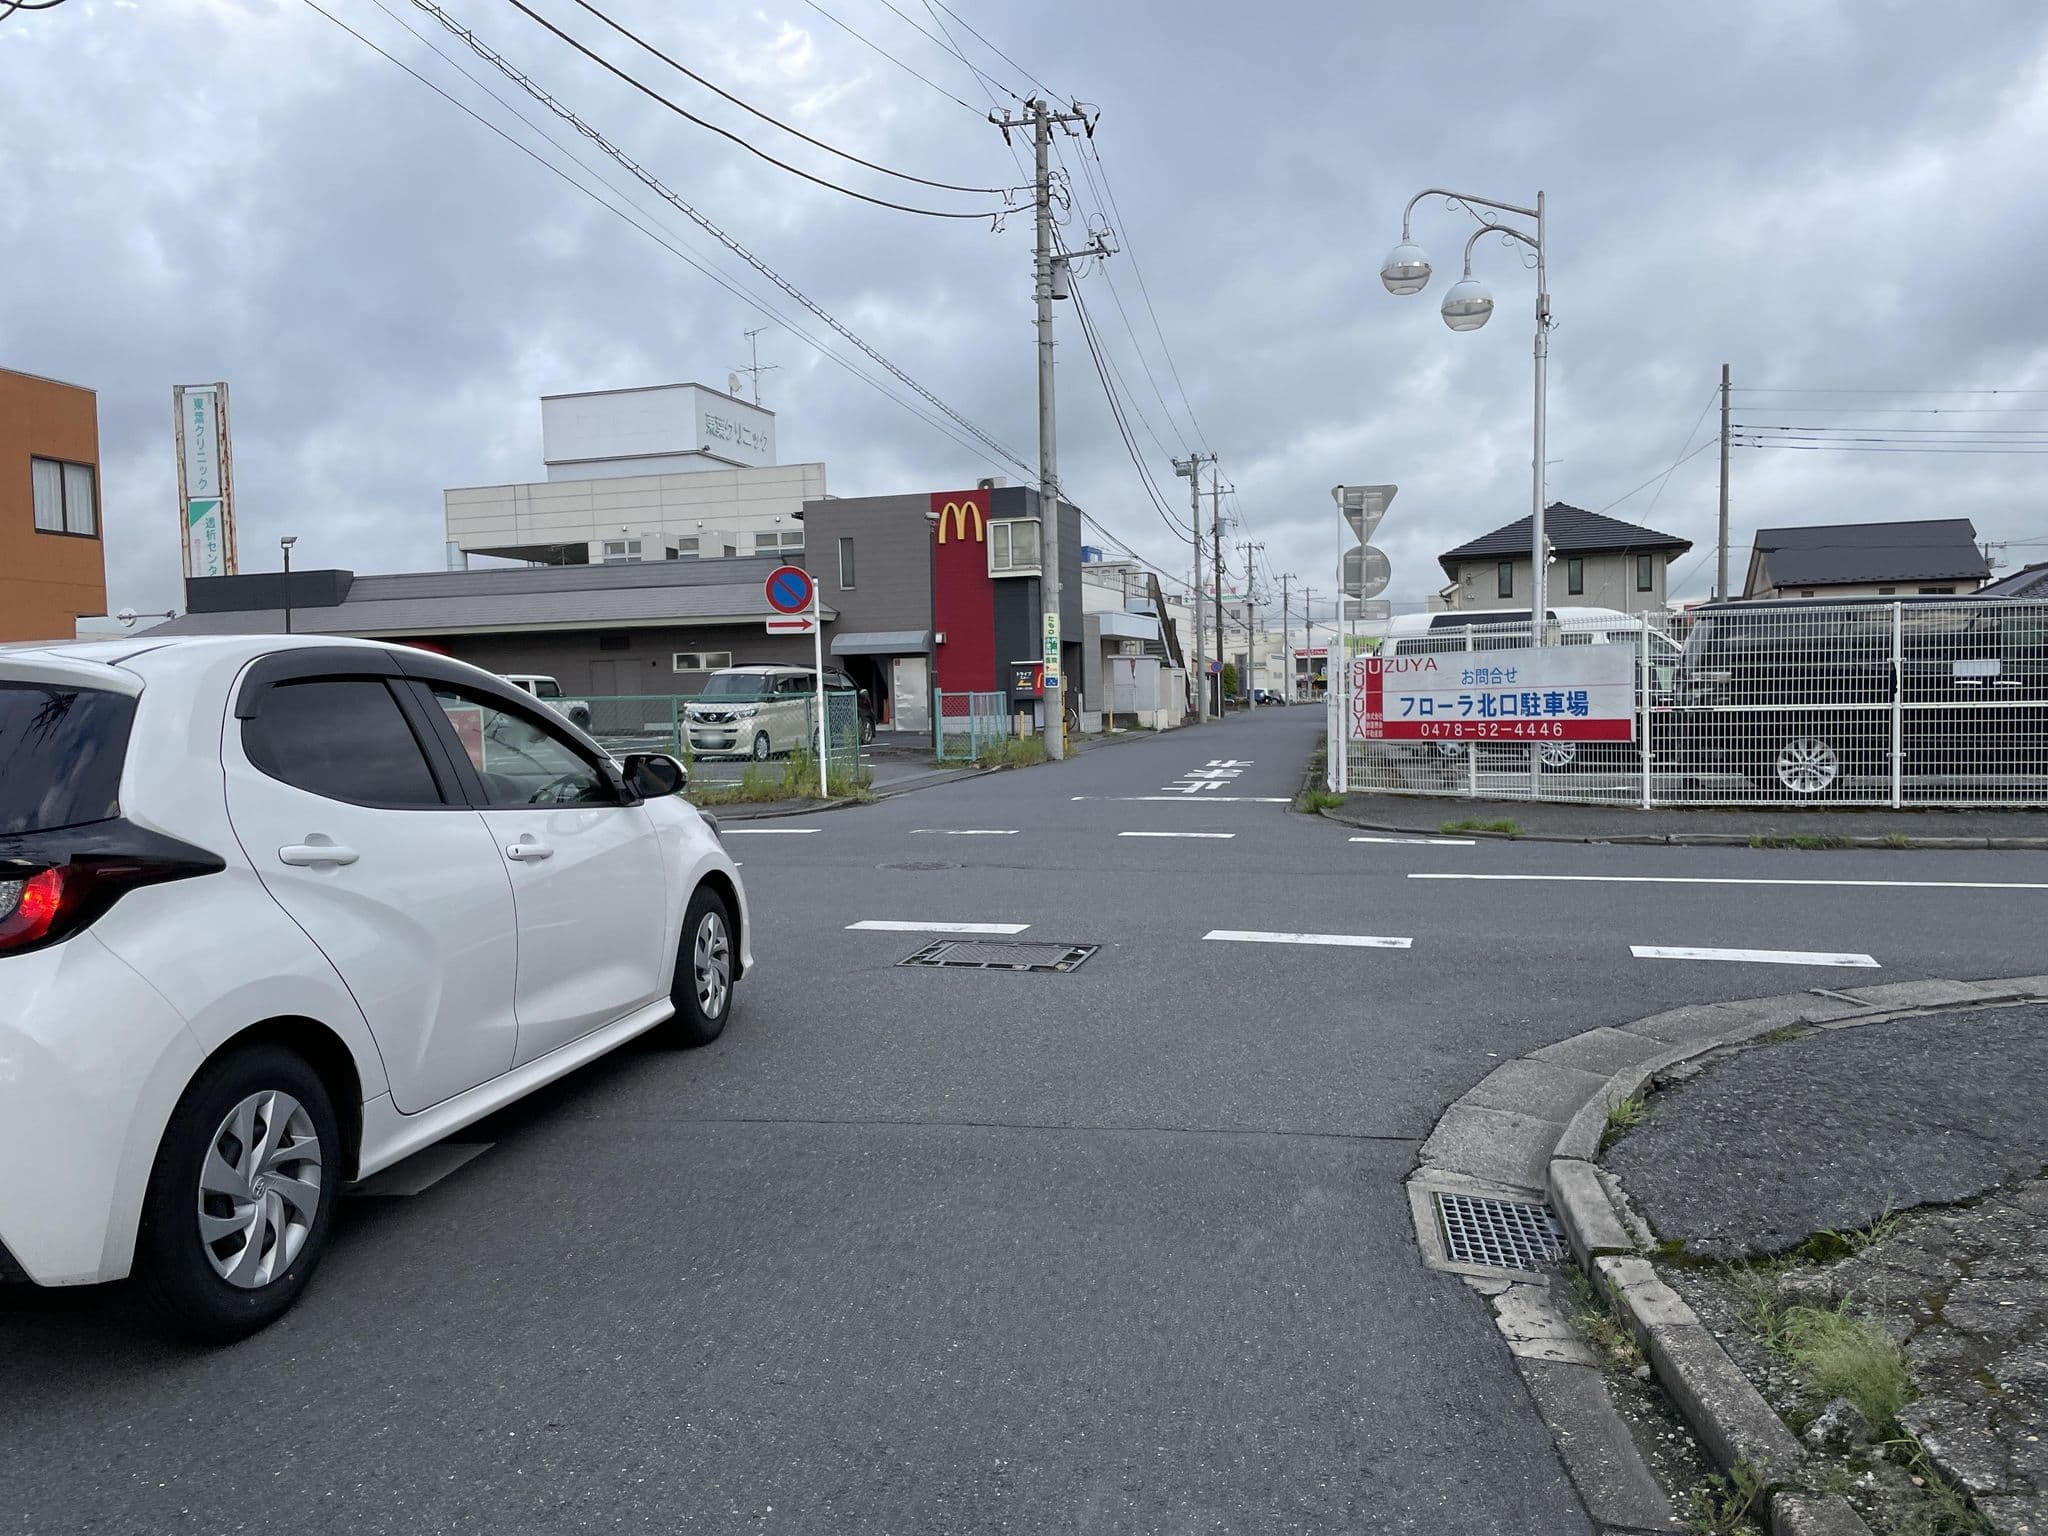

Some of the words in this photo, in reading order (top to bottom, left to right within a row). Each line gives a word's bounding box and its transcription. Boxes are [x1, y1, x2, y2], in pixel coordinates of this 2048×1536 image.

[1461, 667, 1518, 685] お問合せ
[1400, 690, 1590, 717] フローラ北口駐車場
[1421, 722, 1563, 737] 0478-52-4446
